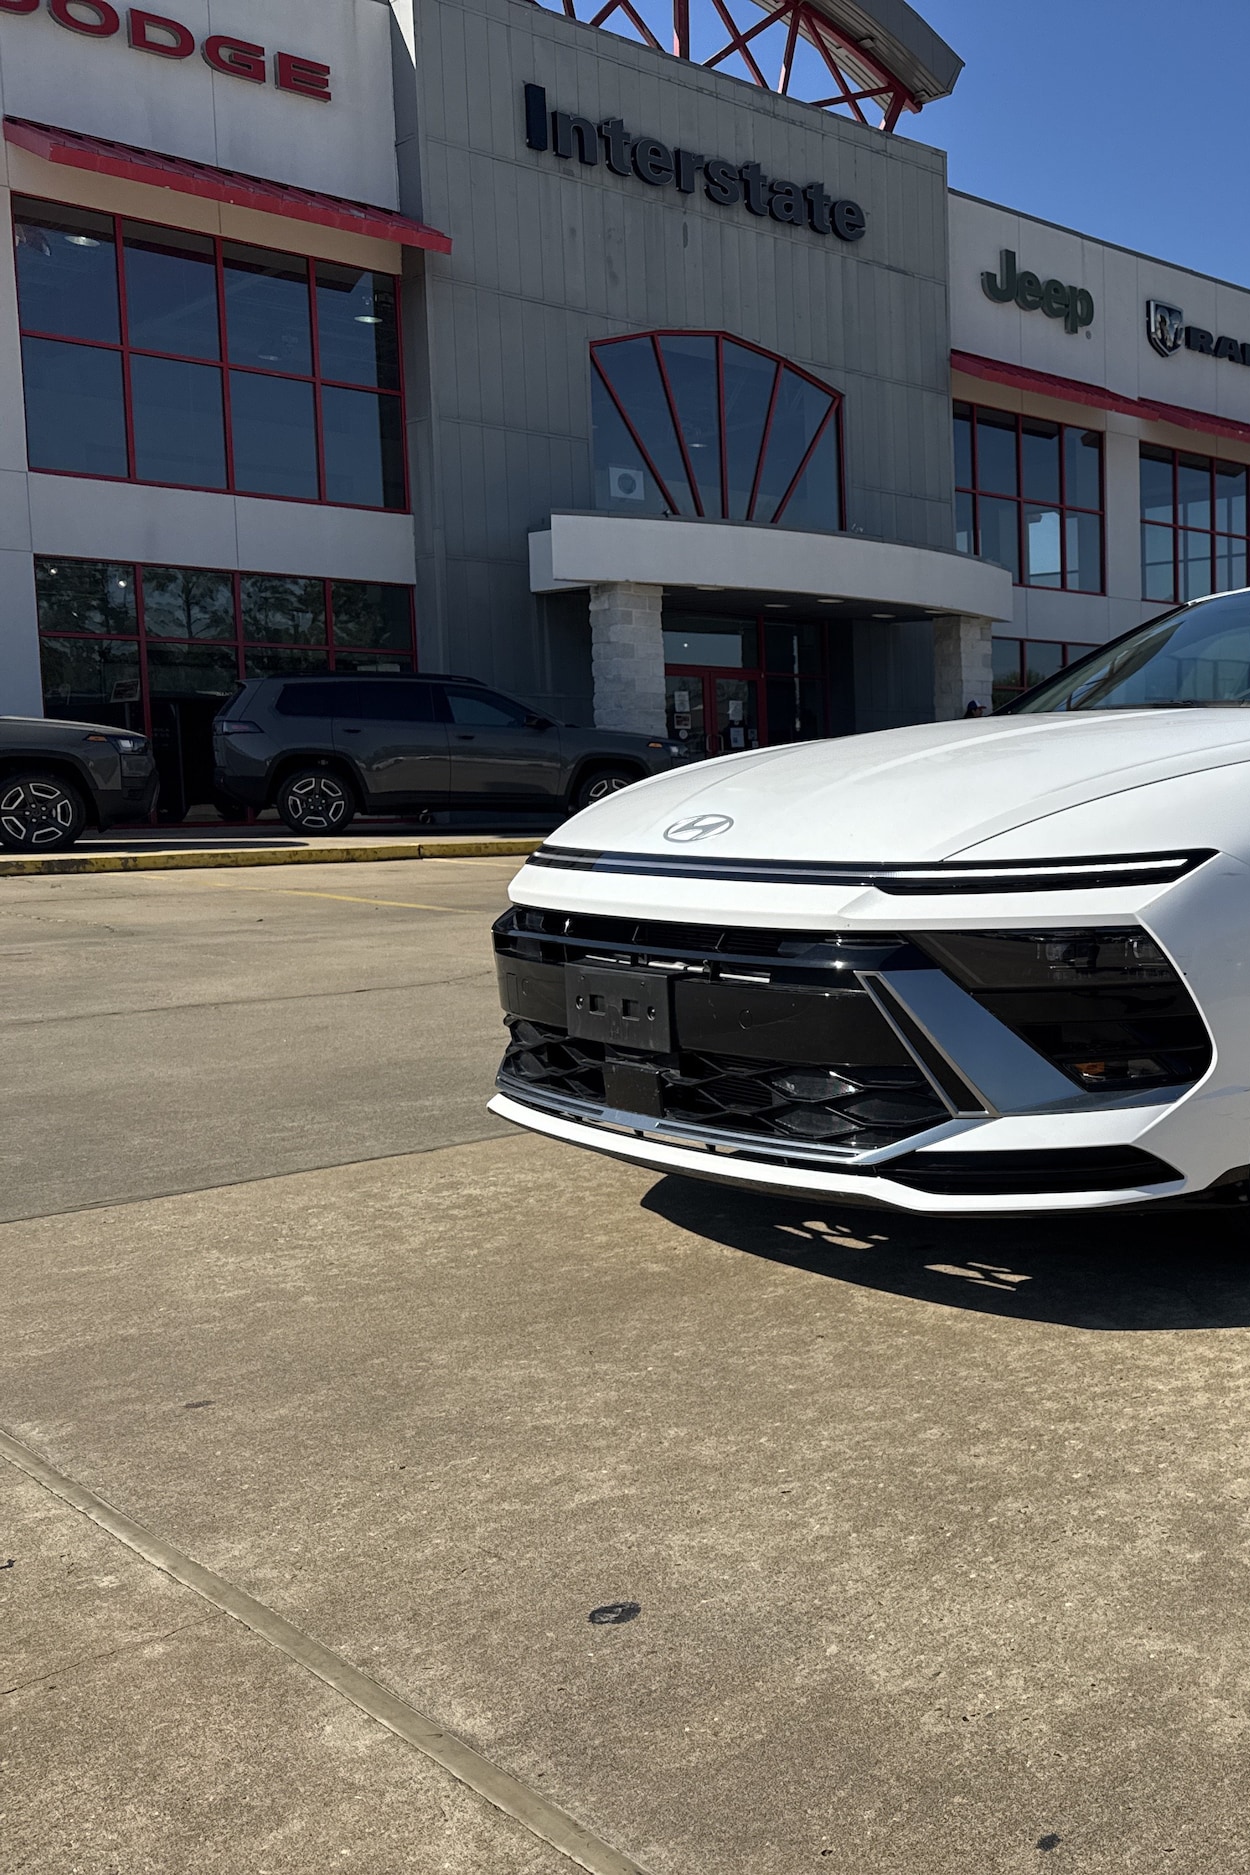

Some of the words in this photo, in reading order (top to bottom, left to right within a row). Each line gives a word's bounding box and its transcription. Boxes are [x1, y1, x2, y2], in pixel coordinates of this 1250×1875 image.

[0, 0, 331, 102] ODGE
[524, 82, 867, 241] Interstate
[980, 249, 1094, 334] Jeep
